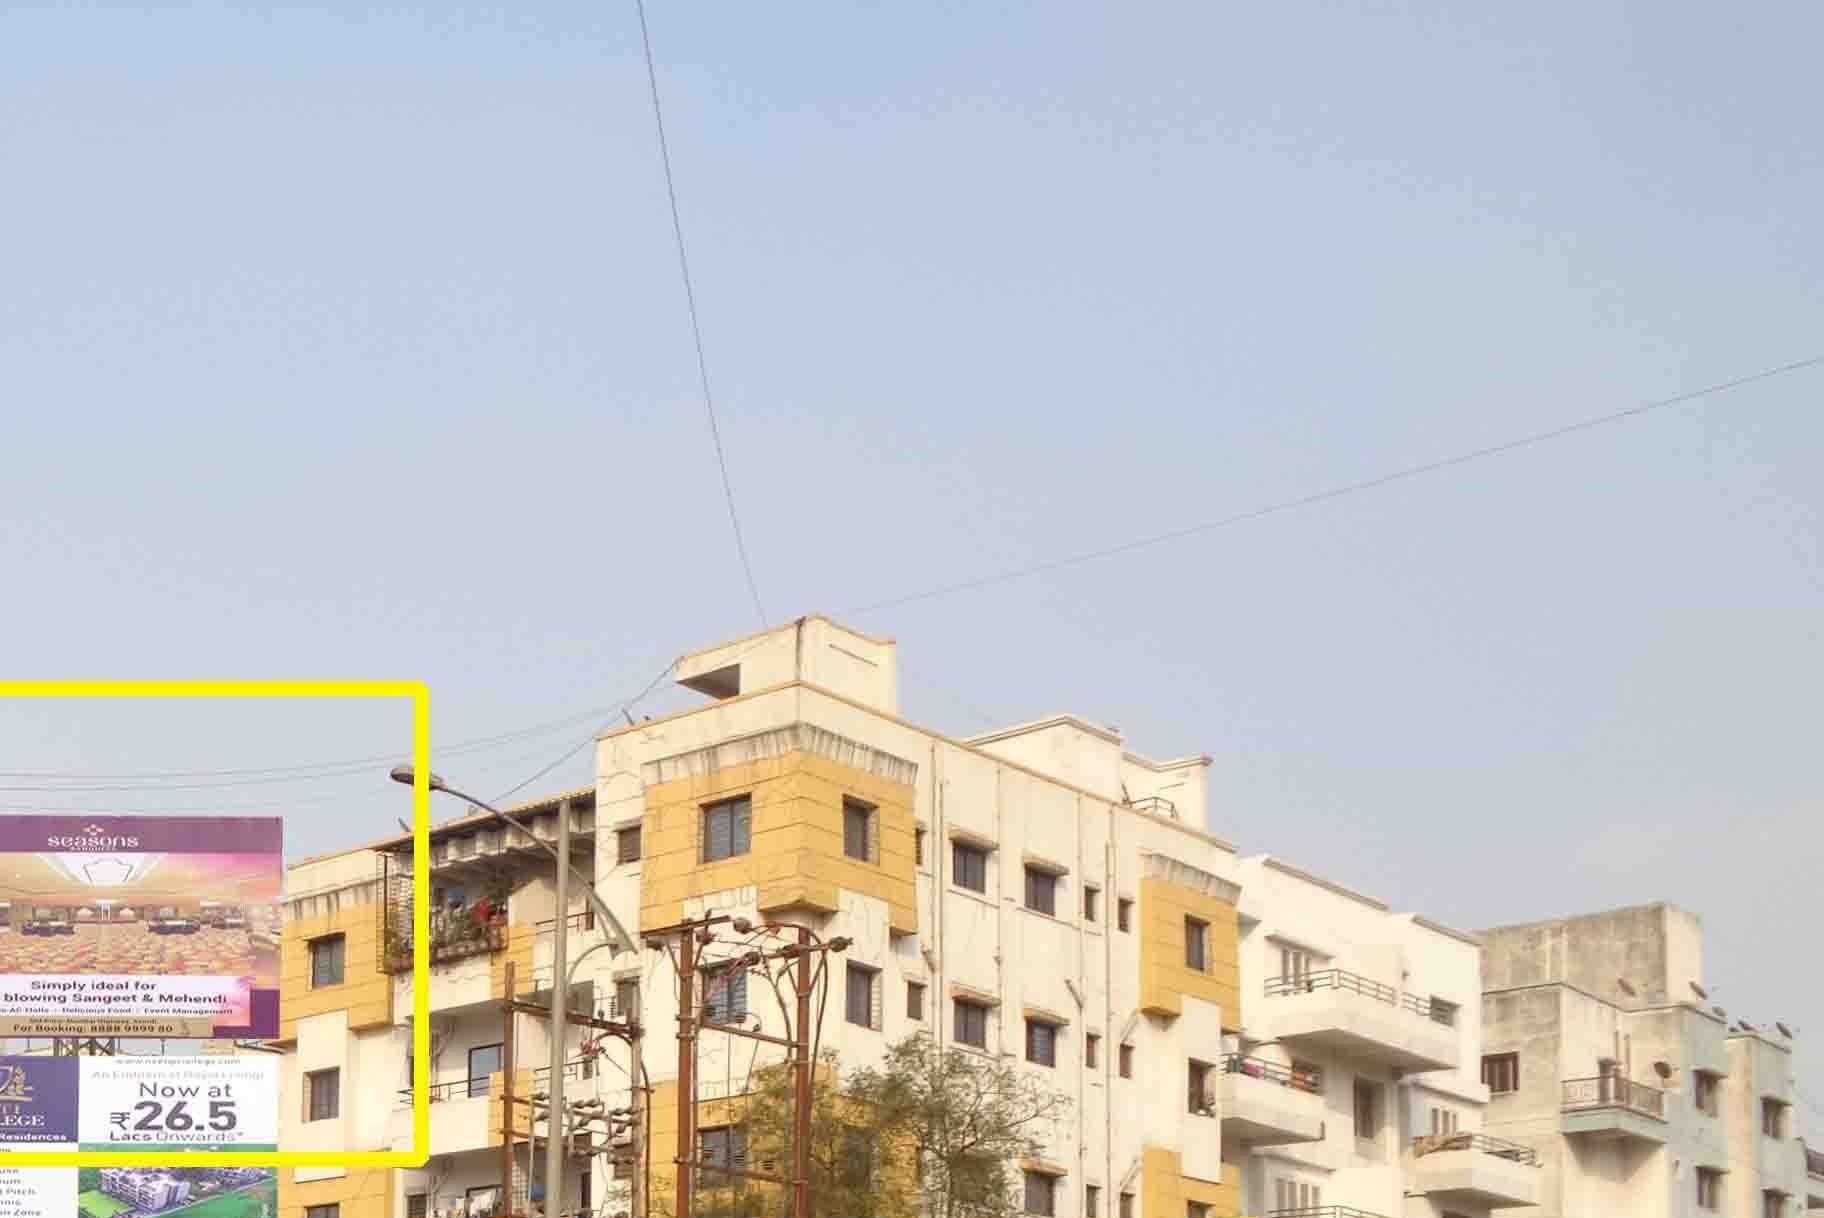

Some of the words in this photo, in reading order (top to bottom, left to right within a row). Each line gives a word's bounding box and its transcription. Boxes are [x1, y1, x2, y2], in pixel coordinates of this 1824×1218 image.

[47, 836, 139, 848] seasons
[31, 980, 86, 991] Simply
[91, 980, 129, 990] ideal
[134, 981, 157, 991] for
[4, 992, 67, 1004] blowing
[72, 993, 137, 1004] Sangeet
[142, 993, 153, 1002] &
[159, 993, 227, 1004] Mehendi
[14, 1024, 31, 1032] For
[35, 1024, 87, 1034] Booking:
[139, 1082, 199, 1097] Now
[208, 1084, 232, 1097] at
[110, 1132, 152, 1141] Lacs
